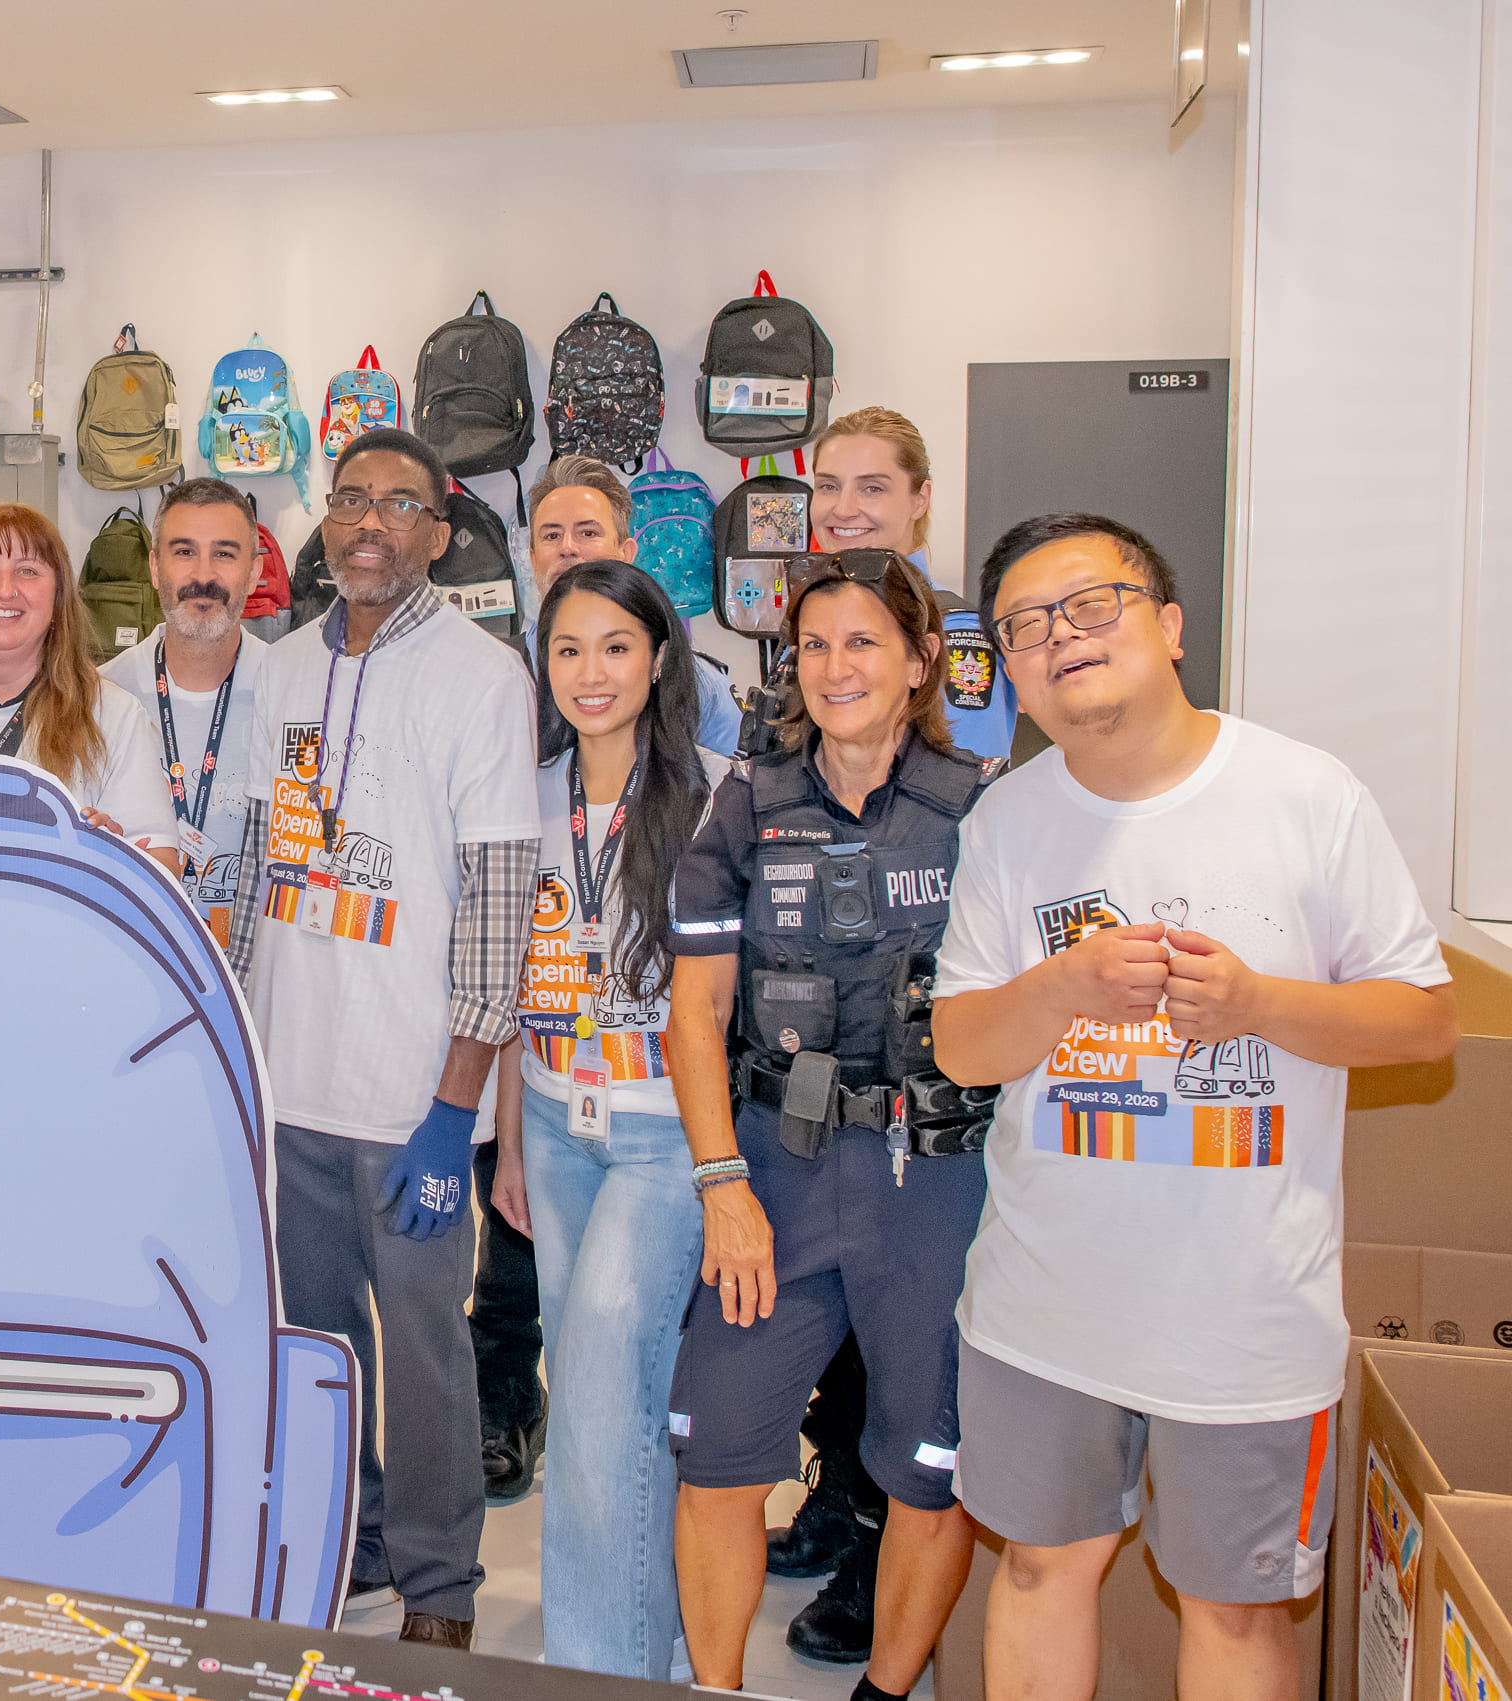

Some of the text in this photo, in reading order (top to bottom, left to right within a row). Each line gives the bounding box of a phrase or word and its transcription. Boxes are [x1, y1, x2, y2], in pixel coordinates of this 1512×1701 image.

[1139, 374, 1197, 388] 019B-3
[286, 726, 321, 746] LINE
[787, 829, 799, 838] De
[801, 830, 831, 840] Angelis
[269, 832, 306, 860] Crew
[285, 870, 301, 884] 29,
[763, 863, 814, 881] NEIGHBOURHOOD
[329, 877, 337, 889] E
[886, 868, 950, 908] POLICE
[771, 887, 806, 903] COMMUNITY
[777, 911, 802, 927] OFFICER
[1042, 897, 1106, 935] LINE
[525, 1016, 554, 1030] August
[1051, 1041, 1128, 1076] Crew
[597, 1074, 605, 1086] E
[1057, 1087, 1159, 1108] August 29, 2026
